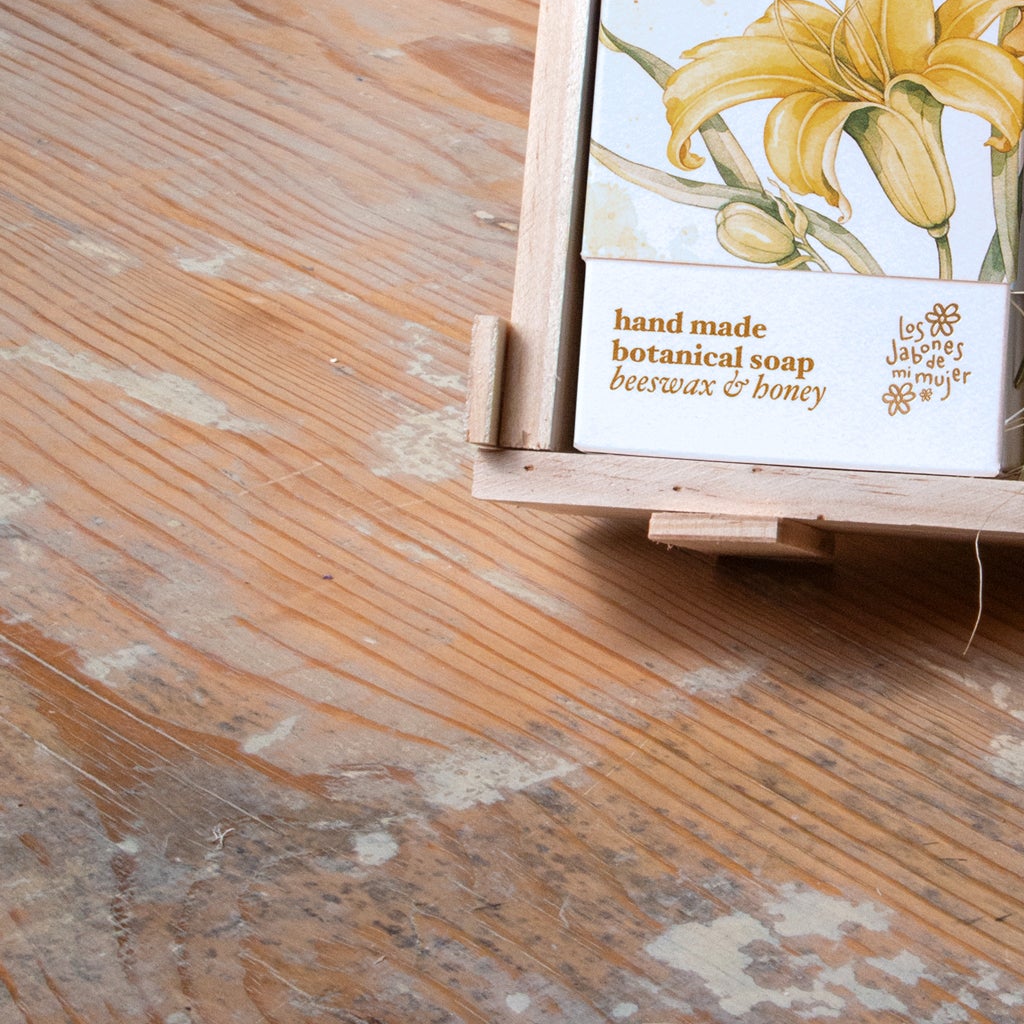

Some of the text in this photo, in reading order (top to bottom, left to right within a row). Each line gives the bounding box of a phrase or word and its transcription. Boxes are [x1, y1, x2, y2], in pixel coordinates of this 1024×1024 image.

[613, 307, 767, 339] hand made
[899, 315, 925, 343] Los
[611, 338, 815, 380] botanical soap
[886, 338, 964, 365] Jabones
[926, 354, 945, 369] de
[609, 365, 826, 411] beeswax & honey
[892, 366, 972, 401] mi mujer
